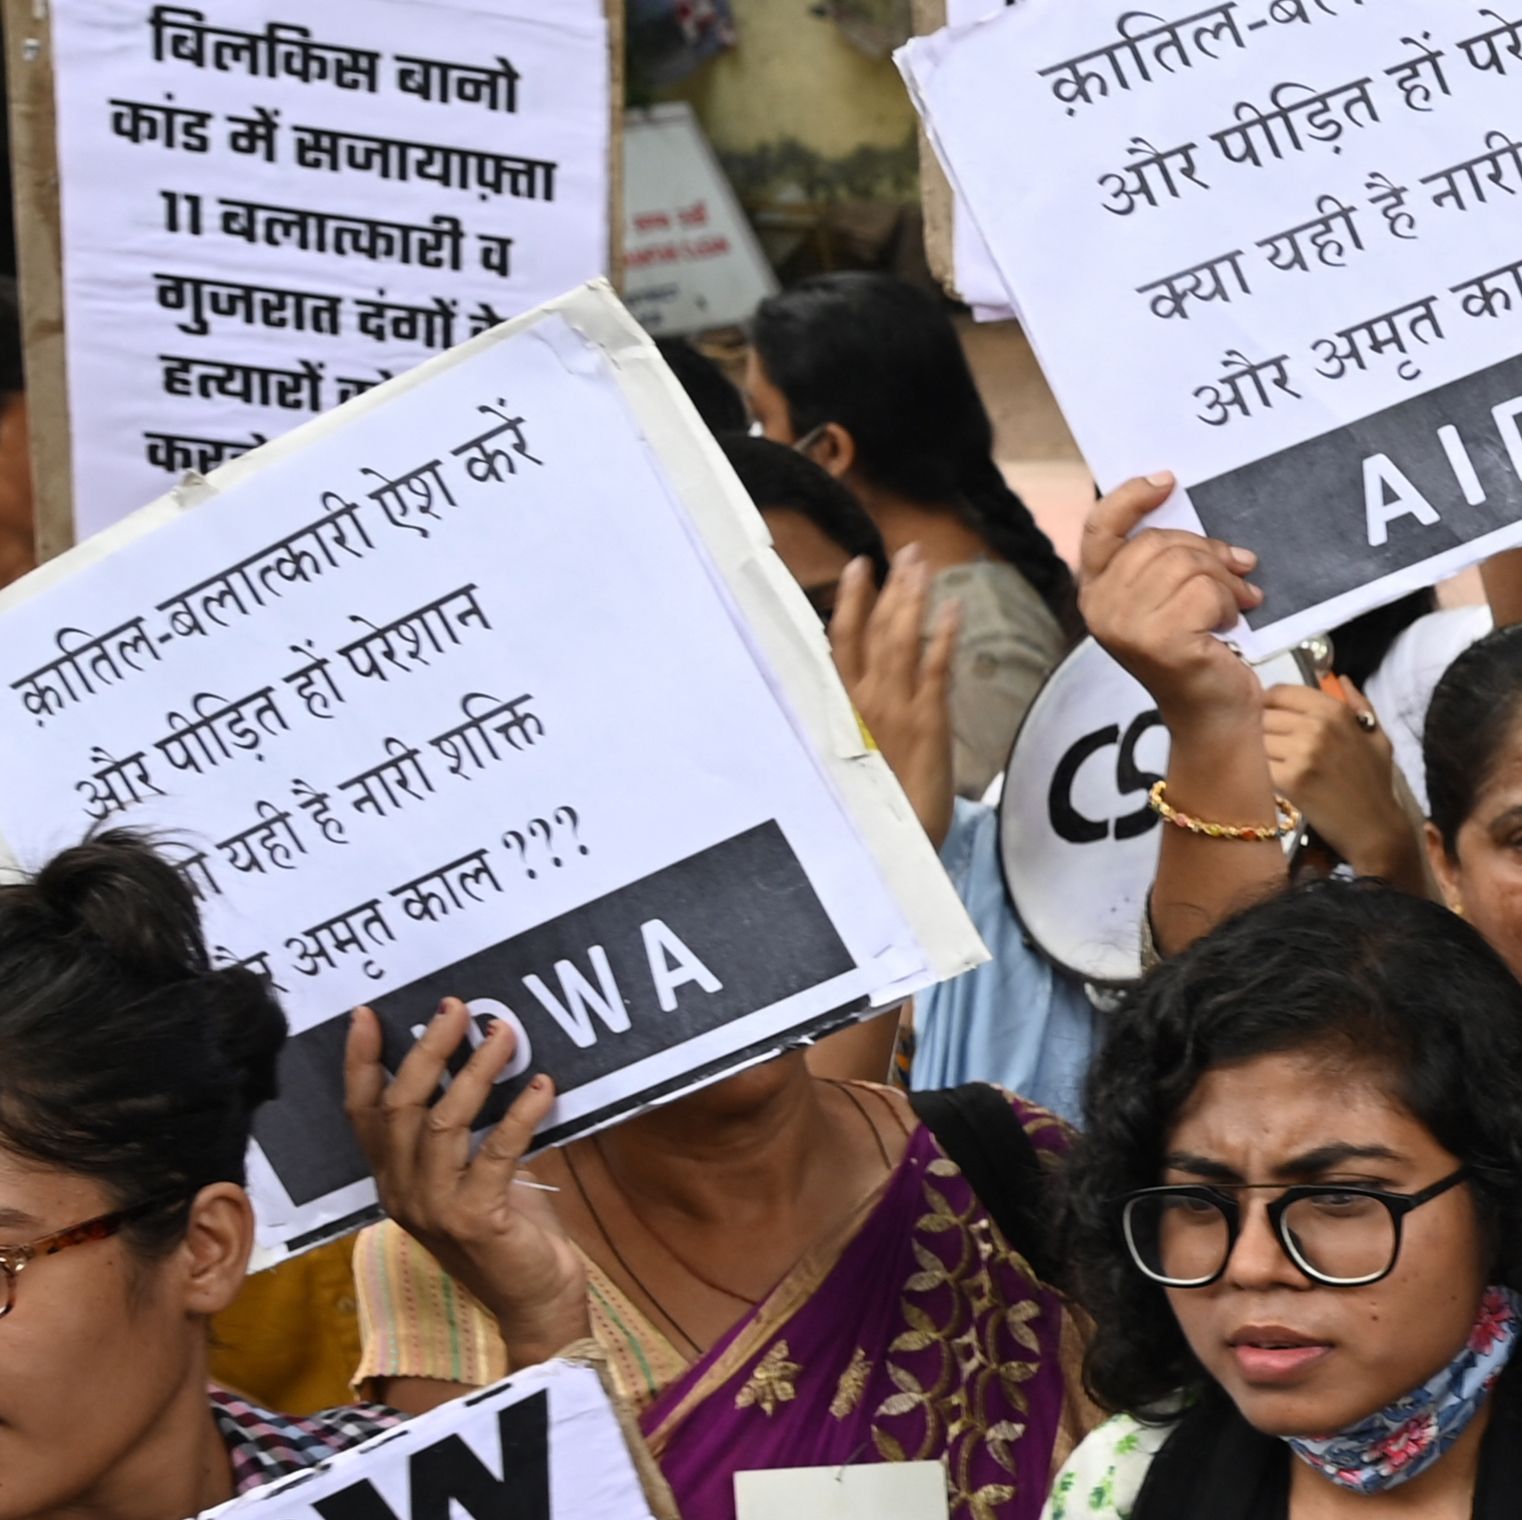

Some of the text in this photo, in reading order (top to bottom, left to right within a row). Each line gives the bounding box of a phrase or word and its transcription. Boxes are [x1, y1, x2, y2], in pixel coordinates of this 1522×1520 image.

[148, 5, 519, 113] बिलकिस बानो
[1100, 138, 1208, 215] और
[1210, 78, 1378, 166] पीड़ित
[1385, 32, 1449, 110] हों
[110, 94, 212, 152] कांड
[227, 107, 279, 162] में
[161, 191, 512, 277] 11 बलात्कारी व
[1138, 251, 1249, 318] क्या
[1257, 196, 1362, 270] यही
[1366, 173, 1413, 238] है
[154, 274, 342, 335] गुजरात
[354, 289, 457, 349] दंगों
[1195, 351, 1300, 425] और
[1313, 296, 1443, 380] अमृत
[159, 355, 324, 412] हत्यारों
[11, 399, 541, 725] क़ातिल-बलात्कारी ऐश करें
[77, 584, 490, 821] और पीड़ित हों परेशान
[216, 693, 542, 872] यही है नारी शक्ति
[1048, 710, 1168, 845] CS
[285, 899, 394, 979] अमृत
[389, 849, 501, 920] काल
[504, 807, 587, 878] ???
